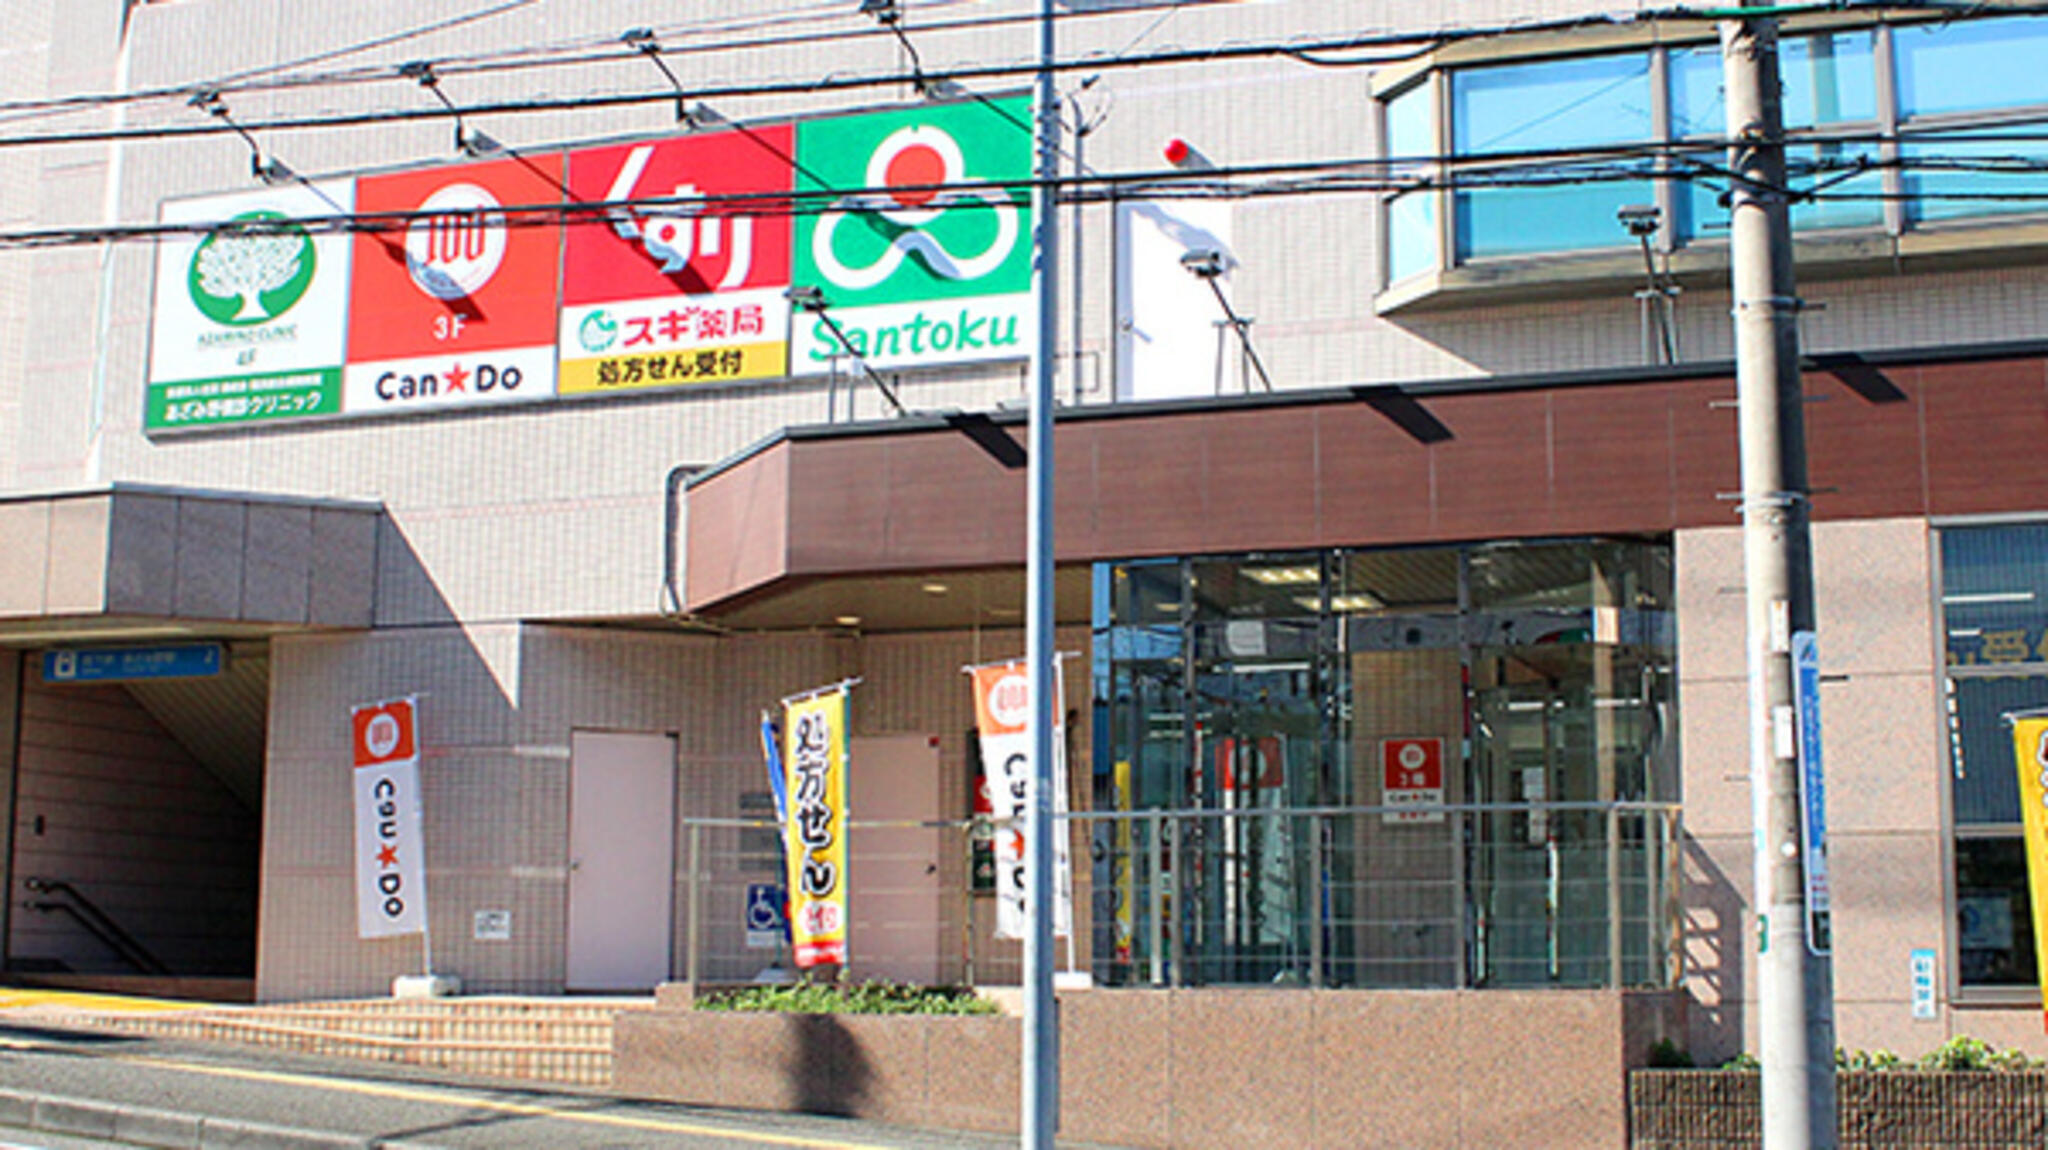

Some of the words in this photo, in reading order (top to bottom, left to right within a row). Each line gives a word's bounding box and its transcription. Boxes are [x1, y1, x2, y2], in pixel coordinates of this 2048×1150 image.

[433, 313, 468, 340] 3F
[622, 304, 766, 347] スギ薬局
[808, 310, 1020, 362] Santoku
[376, 371, 438, 400] Can
[476, 364, 522, 393] Do
[597, 349, 742, 386] 処方せん受付
[374, 778, 397, 840] Can
[795, 709, 836, 898] 処方せん
[377, 873, 404, 918] Do
